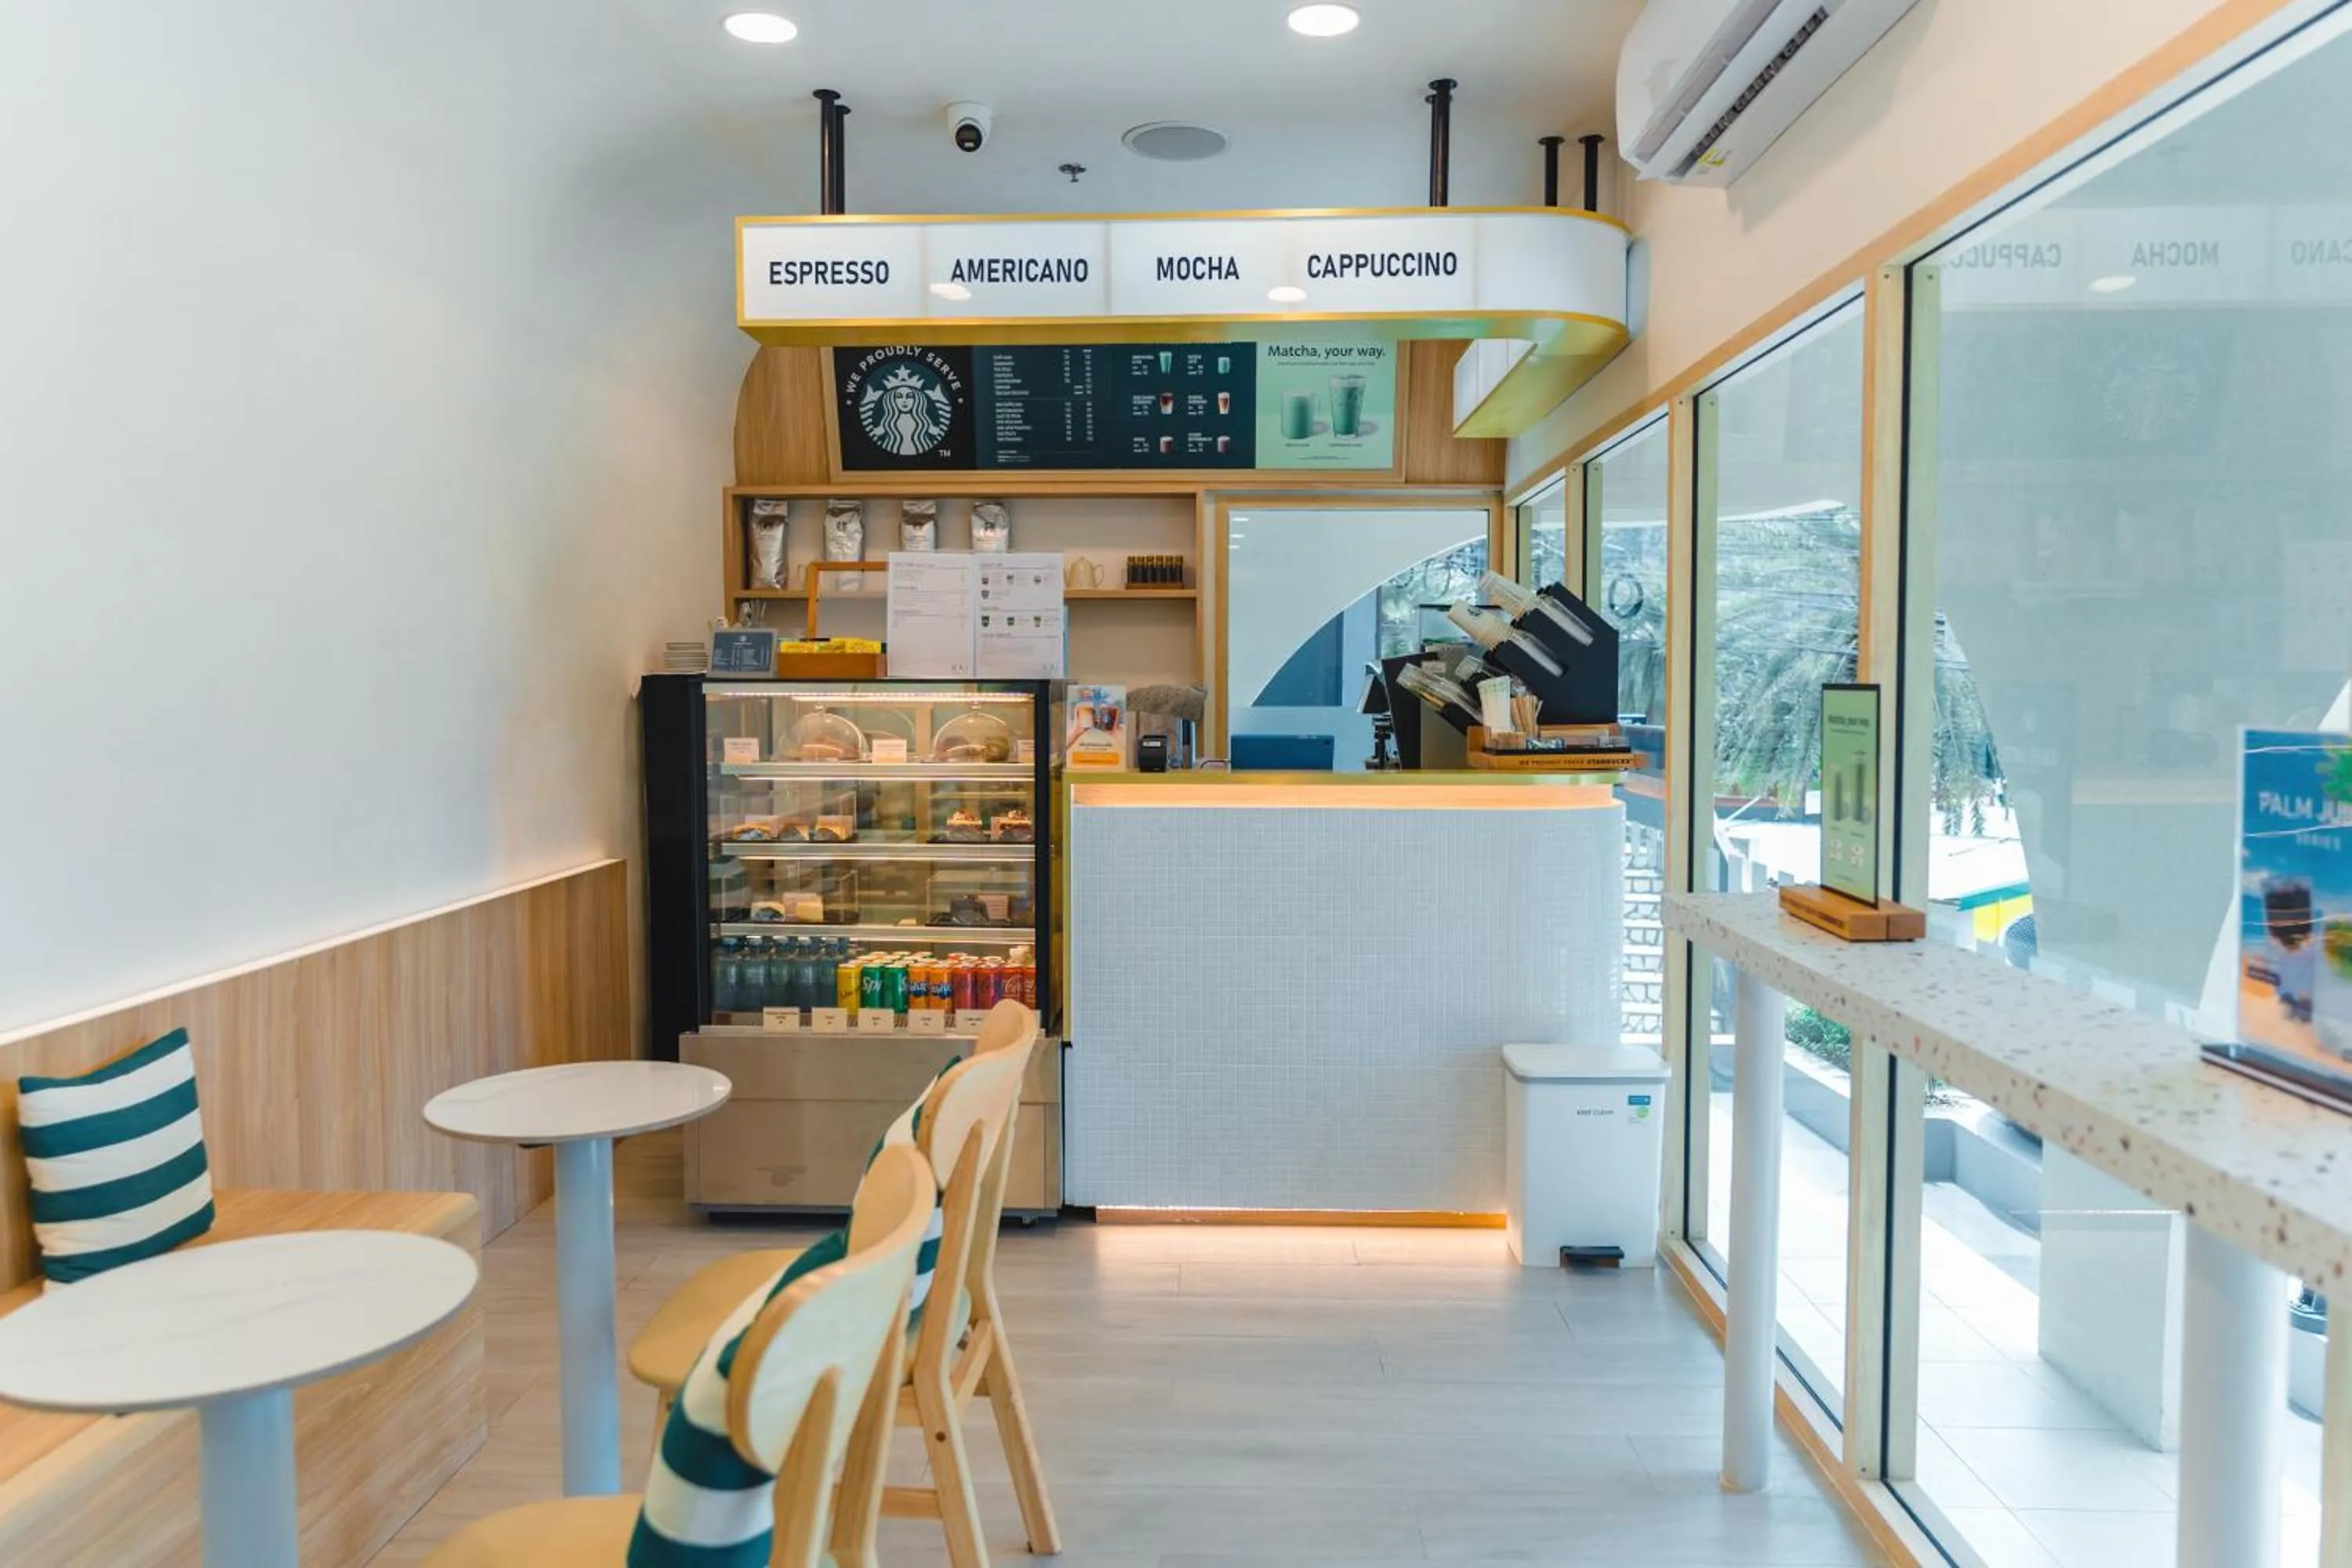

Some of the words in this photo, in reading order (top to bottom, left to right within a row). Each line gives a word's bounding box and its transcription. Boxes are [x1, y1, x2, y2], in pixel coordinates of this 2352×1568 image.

[769, 260, 890, 285] ESPRESSO
[949, 258, 1089, 283] AMERICANO
[1156, 256, 1240, 281] MOCHA
[1307, 252, 1457, 278] CAPPUCCINO
[1268, 345, 1322, 358] Matcha,
[1324, 347, 1353, 360] your
[1357, 347, 1386, 360] way.
[846, 372, 862, 393] WE
[859, 346, 923, 372] PROUDLY
[926, 353, 962, 391] SERVE
[2259, 790, 2314, 820] PALM
